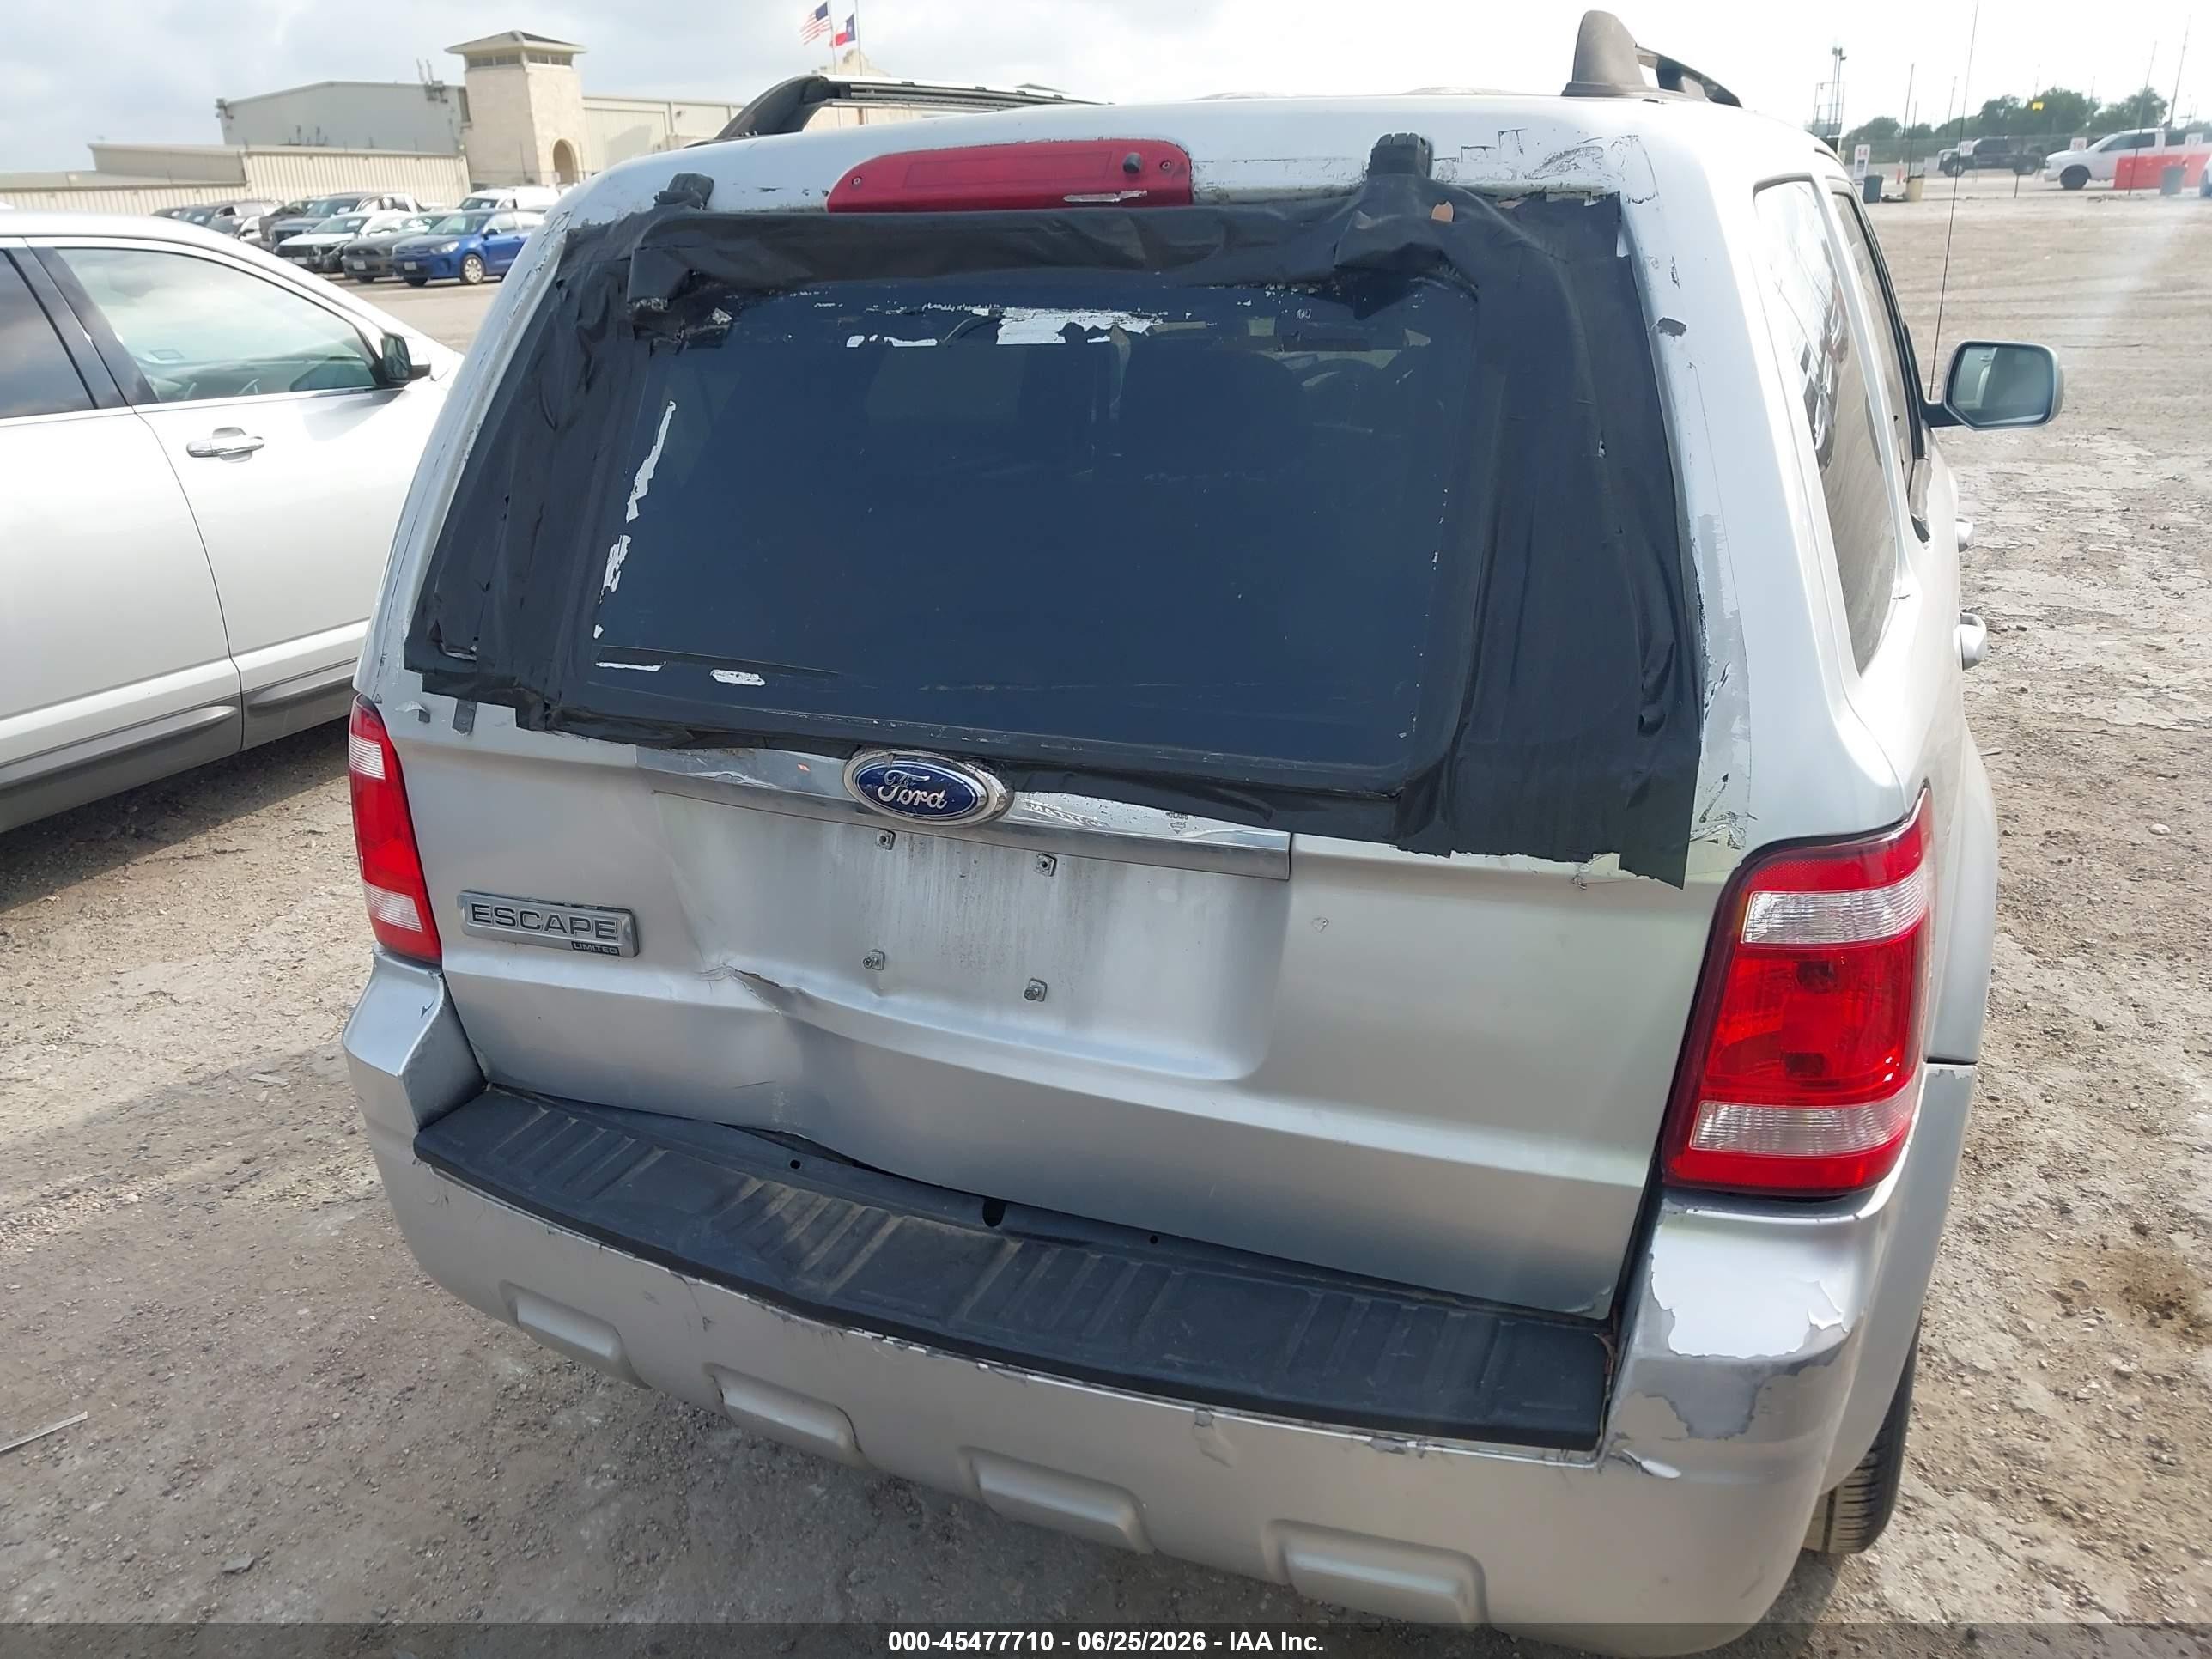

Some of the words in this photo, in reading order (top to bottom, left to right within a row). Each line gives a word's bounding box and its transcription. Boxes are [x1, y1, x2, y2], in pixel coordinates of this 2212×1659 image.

[878, 769, 948, 810] Ford
[471, 902, 617, 941] ESCAPE
[573, 942, 618, 955] LIMITED
